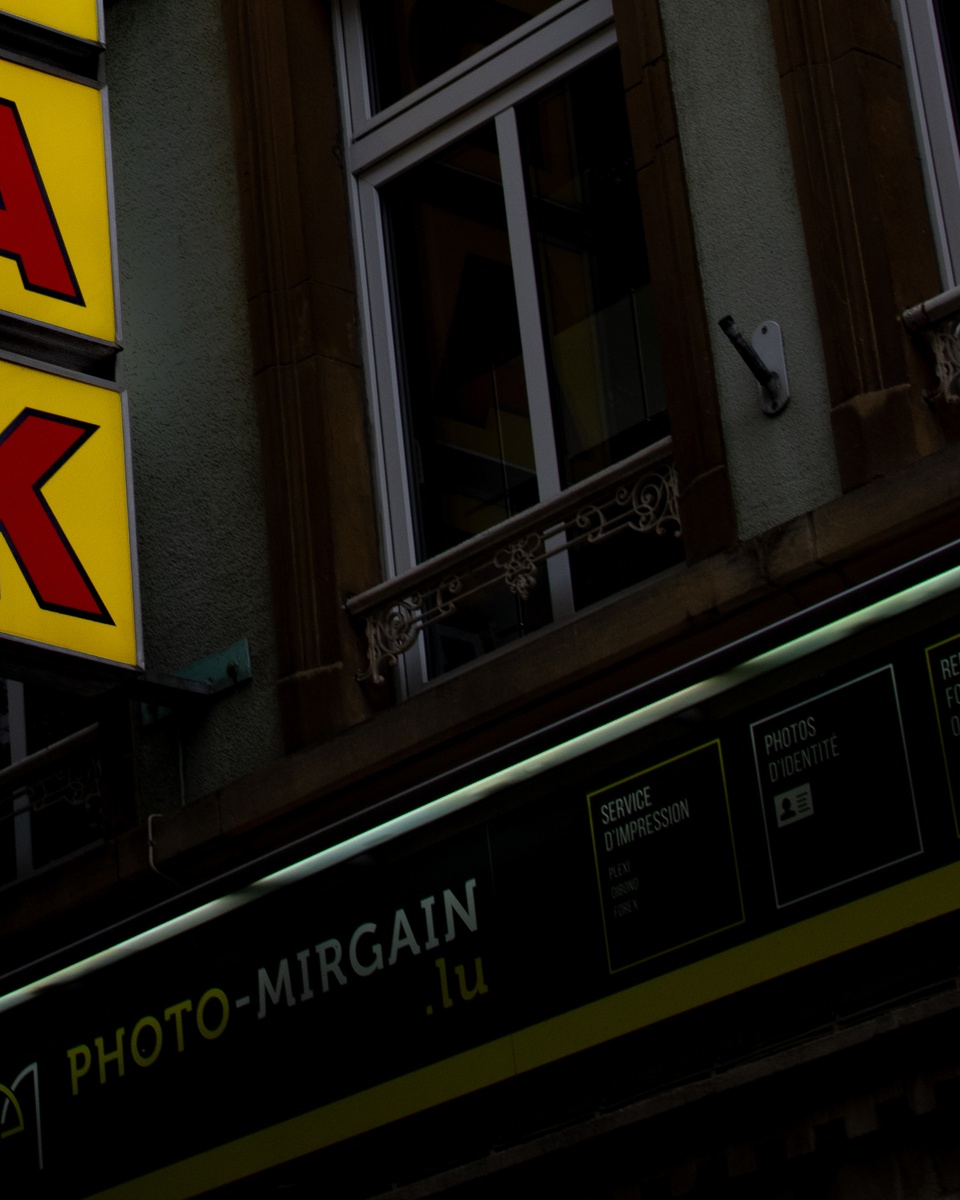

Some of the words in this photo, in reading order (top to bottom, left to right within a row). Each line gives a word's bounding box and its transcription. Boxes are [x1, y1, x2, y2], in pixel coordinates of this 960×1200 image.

[940, 651, 960, 681] RE
[764, 715, 817, 756] PHOTOS
[768, 731, 840, 784] D'IDENTITÉ
[600, 785, 654, 826] SERVICE
[603, 798, 691, 853] D'IMPRESSION
[66, 877, 478, 1097] PHOTO-MIRGAIN
[425, 955, 490, 1017] .lu
